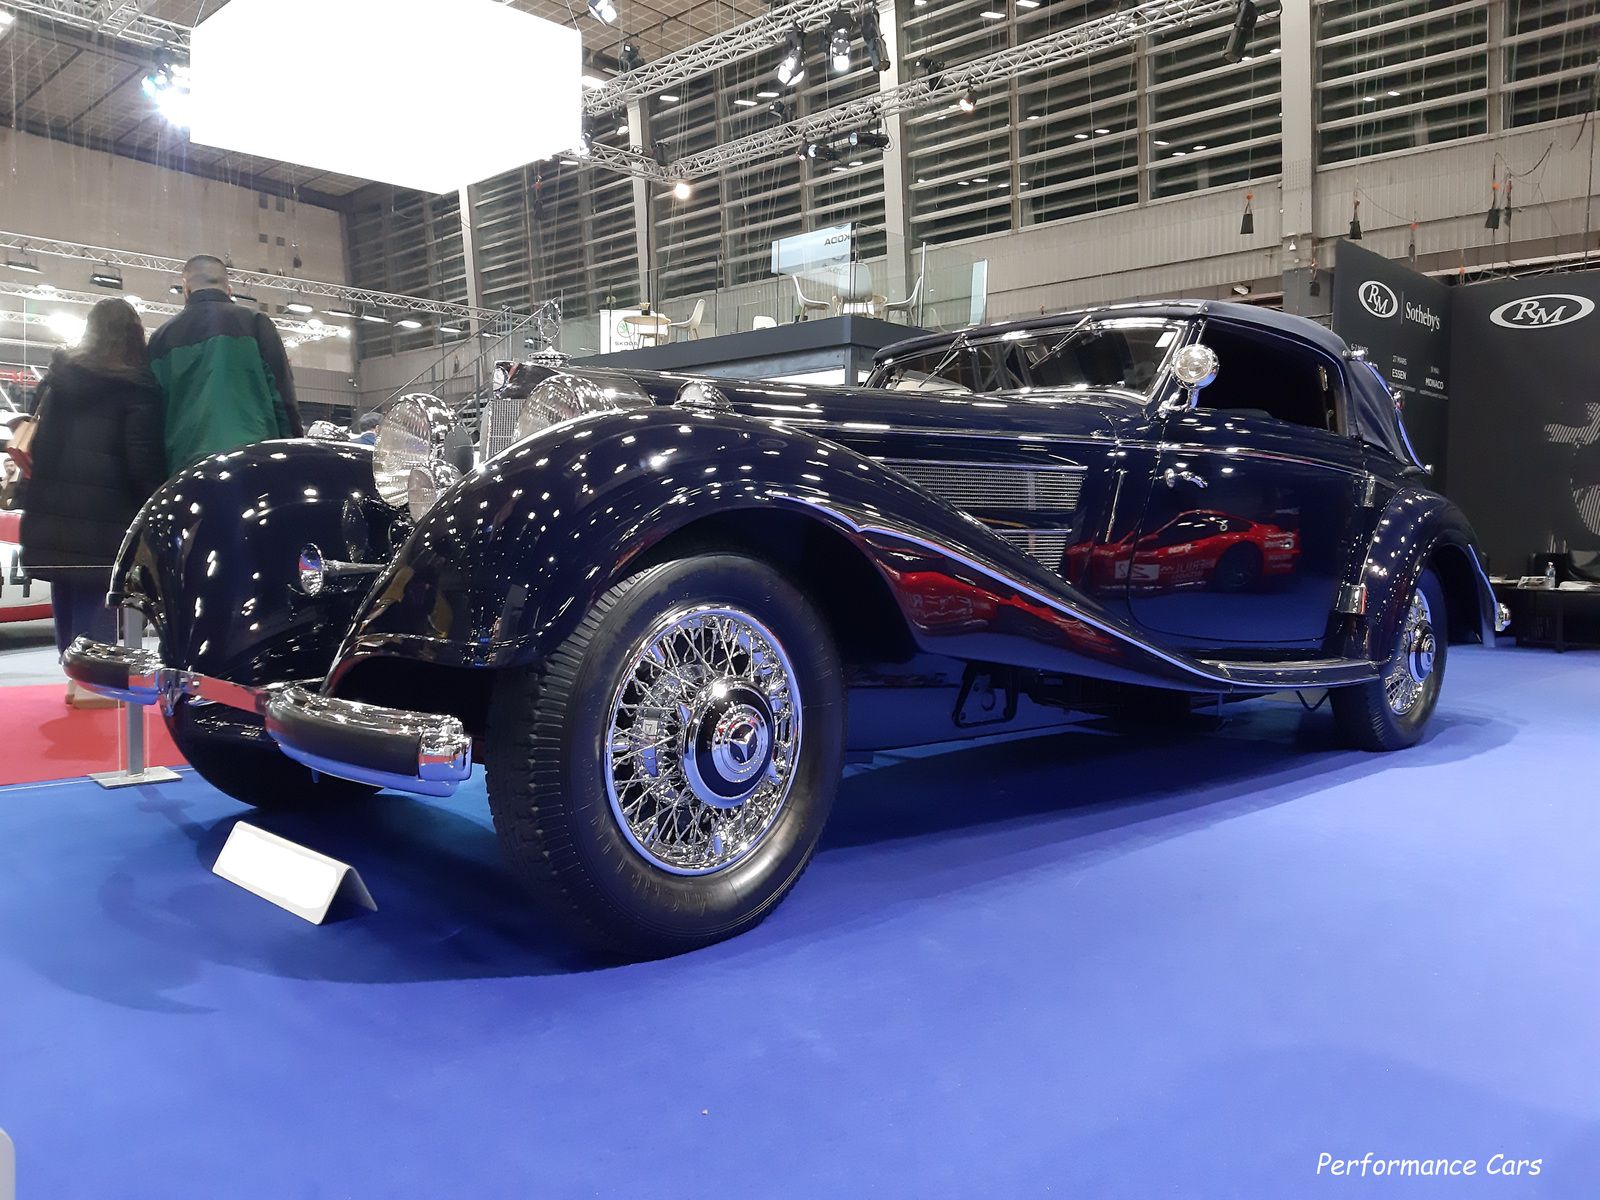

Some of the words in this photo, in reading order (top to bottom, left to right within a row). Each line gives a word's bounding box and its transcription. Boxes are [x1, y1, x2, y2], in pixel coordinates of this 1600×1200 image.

[1367, 284, 1389, 315] RM
[1405, 301, 1440, 332] Sotheby's
[1512, 300, 1567, 325] RM
[1391, 368, 1407, 380] ESSEN
[1425, 377, 1444, 390] MONACO
